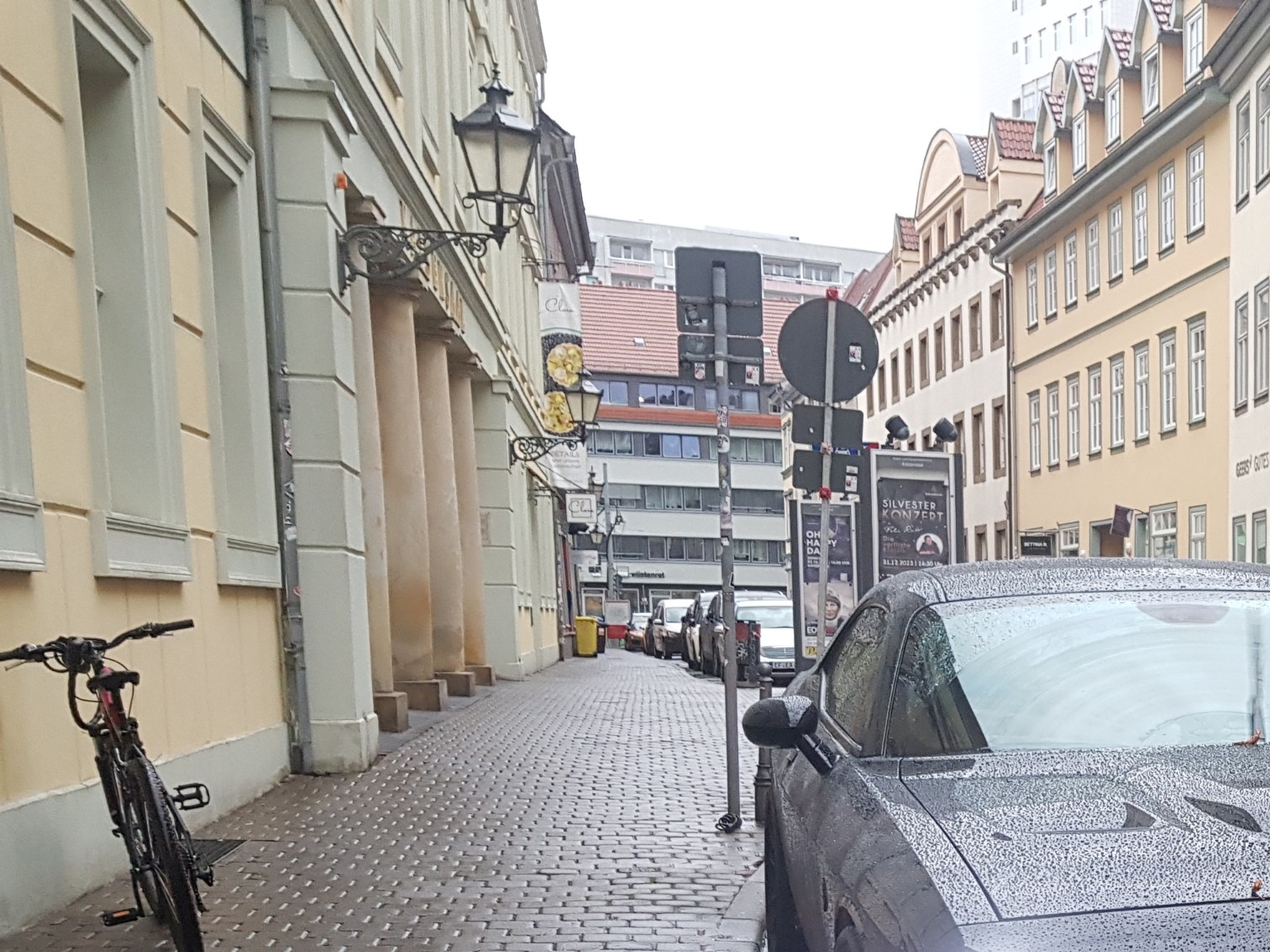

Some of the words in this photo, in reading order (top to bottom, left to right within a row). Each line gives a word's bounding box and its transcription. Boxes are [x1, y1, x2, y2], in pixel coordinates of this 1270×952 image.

[882, 500, 936, 511] SILVESTER
[882, 509, 944, 522] KONZERT
[806, 530, 821, 538] OH
